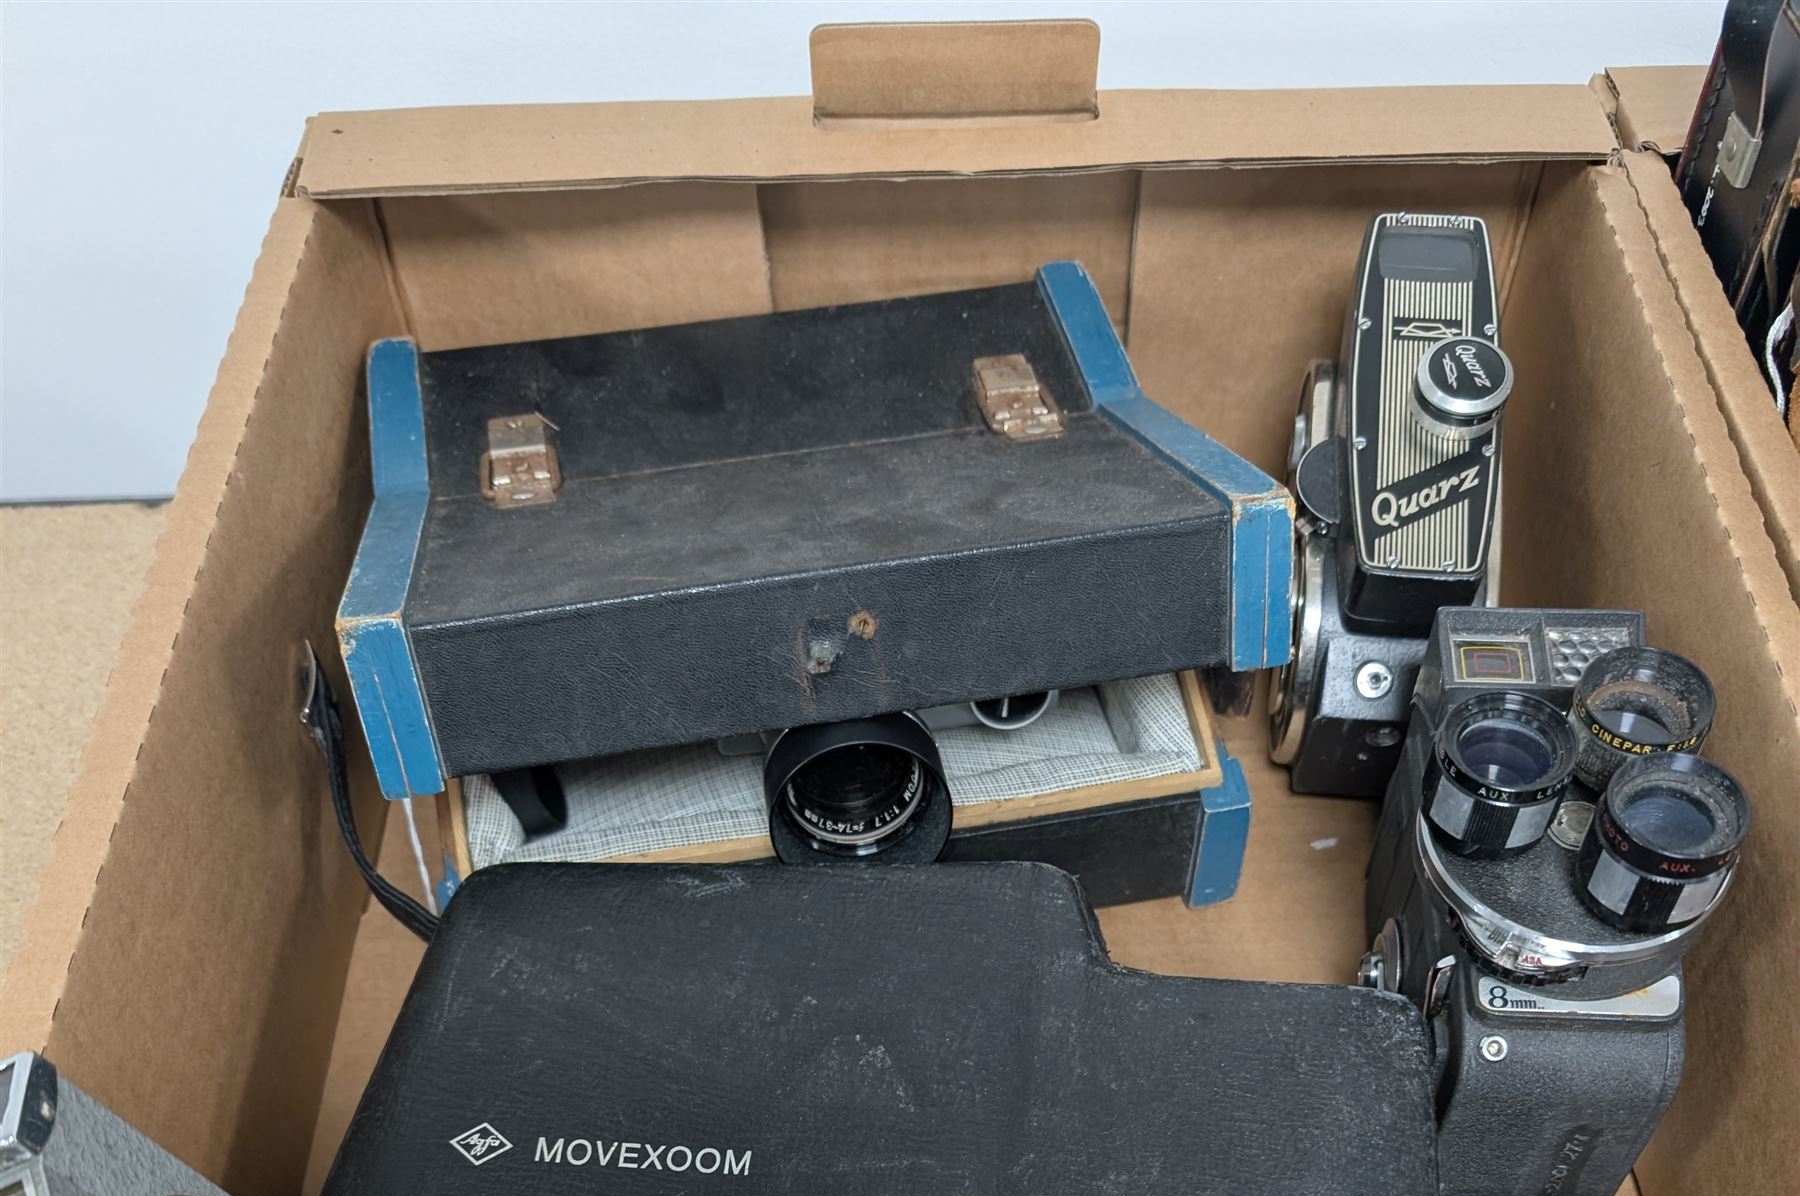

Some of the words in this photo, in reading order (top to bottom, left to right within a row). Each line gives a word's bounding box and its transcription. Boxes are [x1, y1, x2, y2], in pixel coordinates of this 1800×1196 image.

[1455, 344, 1491, 389] Quarz
[1371, 464, 1480, 529] Quarz
[1477, 786, 1510, 801] AUX
[874, 805, 901, 829] 1:1.7
[459, 1132, 501, 1156] Agfa
[533, 1136, 753, 1176] MOVEXOOM
